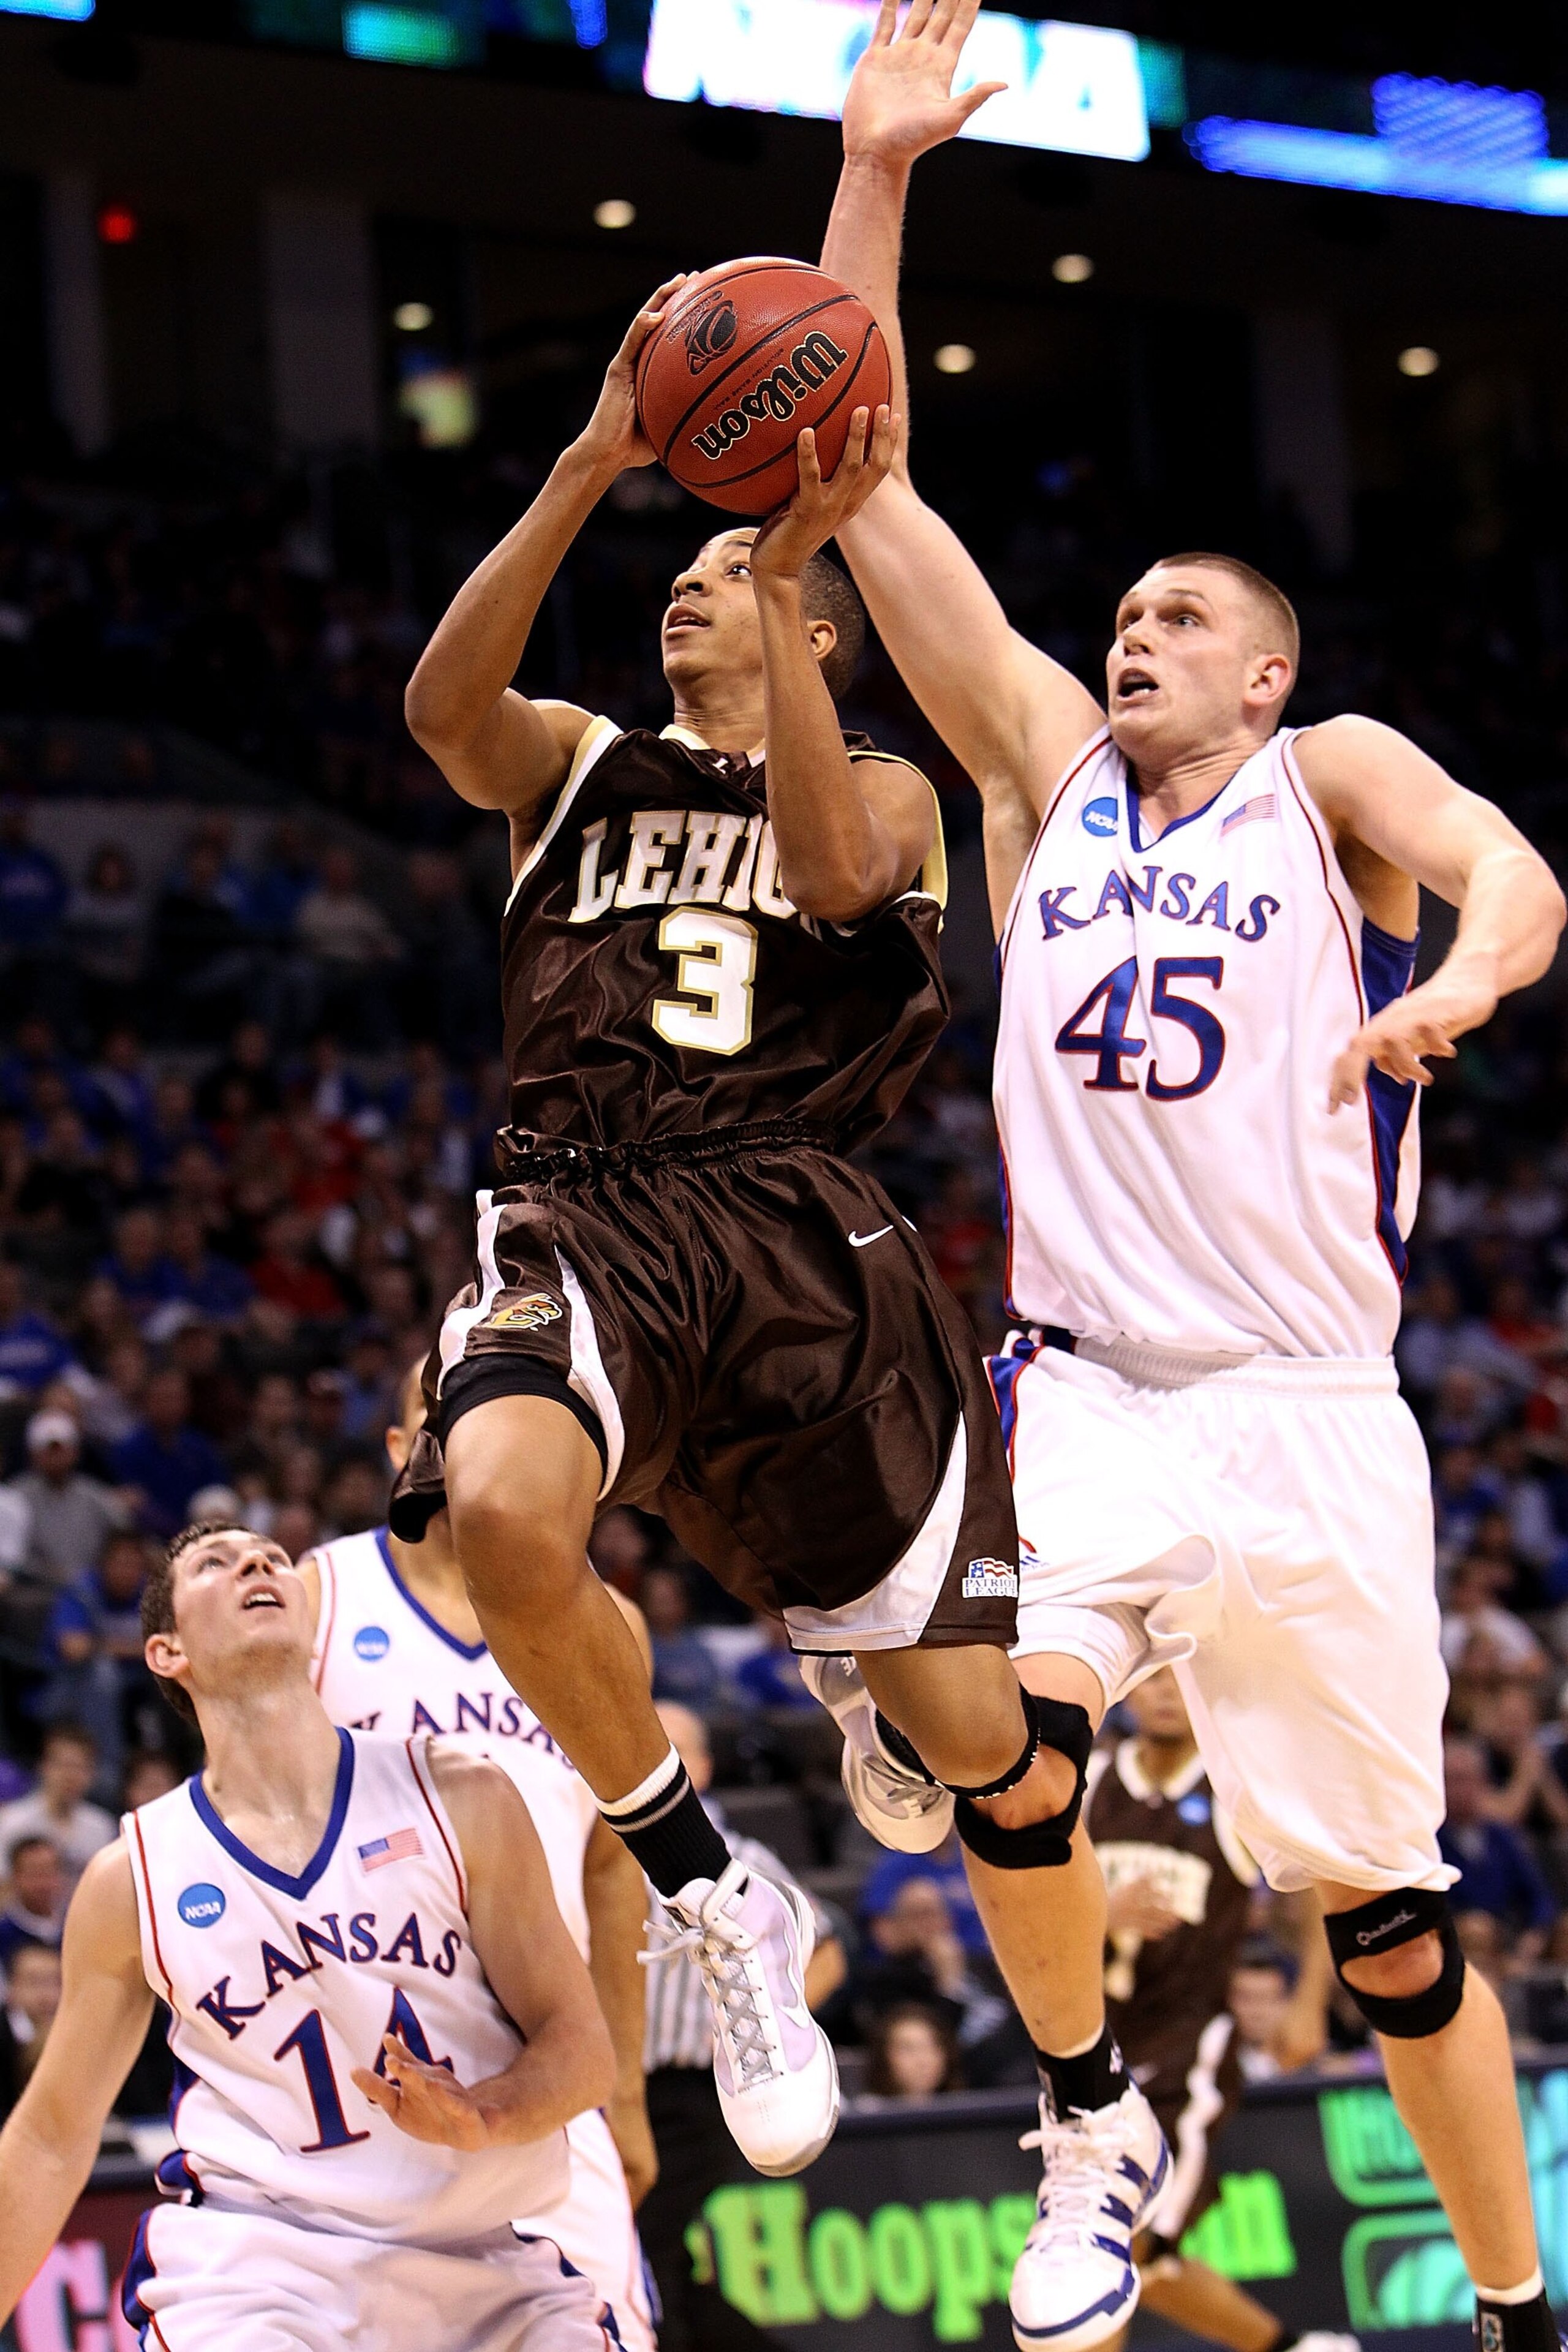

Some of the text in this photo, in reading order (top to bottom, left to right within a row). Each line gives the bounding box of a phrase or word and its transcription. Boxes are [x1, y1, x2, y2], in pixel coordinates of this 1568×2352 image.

[691, 330, 849, 460] Wilson
[1038, 865, 1281, 942] KANSAS
[652, 906, 758, 1057] 3
[1054, 954, 1226, 1102] 45
[965, 1578, 1015, 1588] PATRIOT
[966, 1587, 1016, 1596] LEAGUE
[184, 1901, 222, 1920] NCAA
[195, 1912, 464, 2041] KANSAS
[273, 1985, 455, 2154] 14
[685, 2180, 1039, 2343] Hoops
